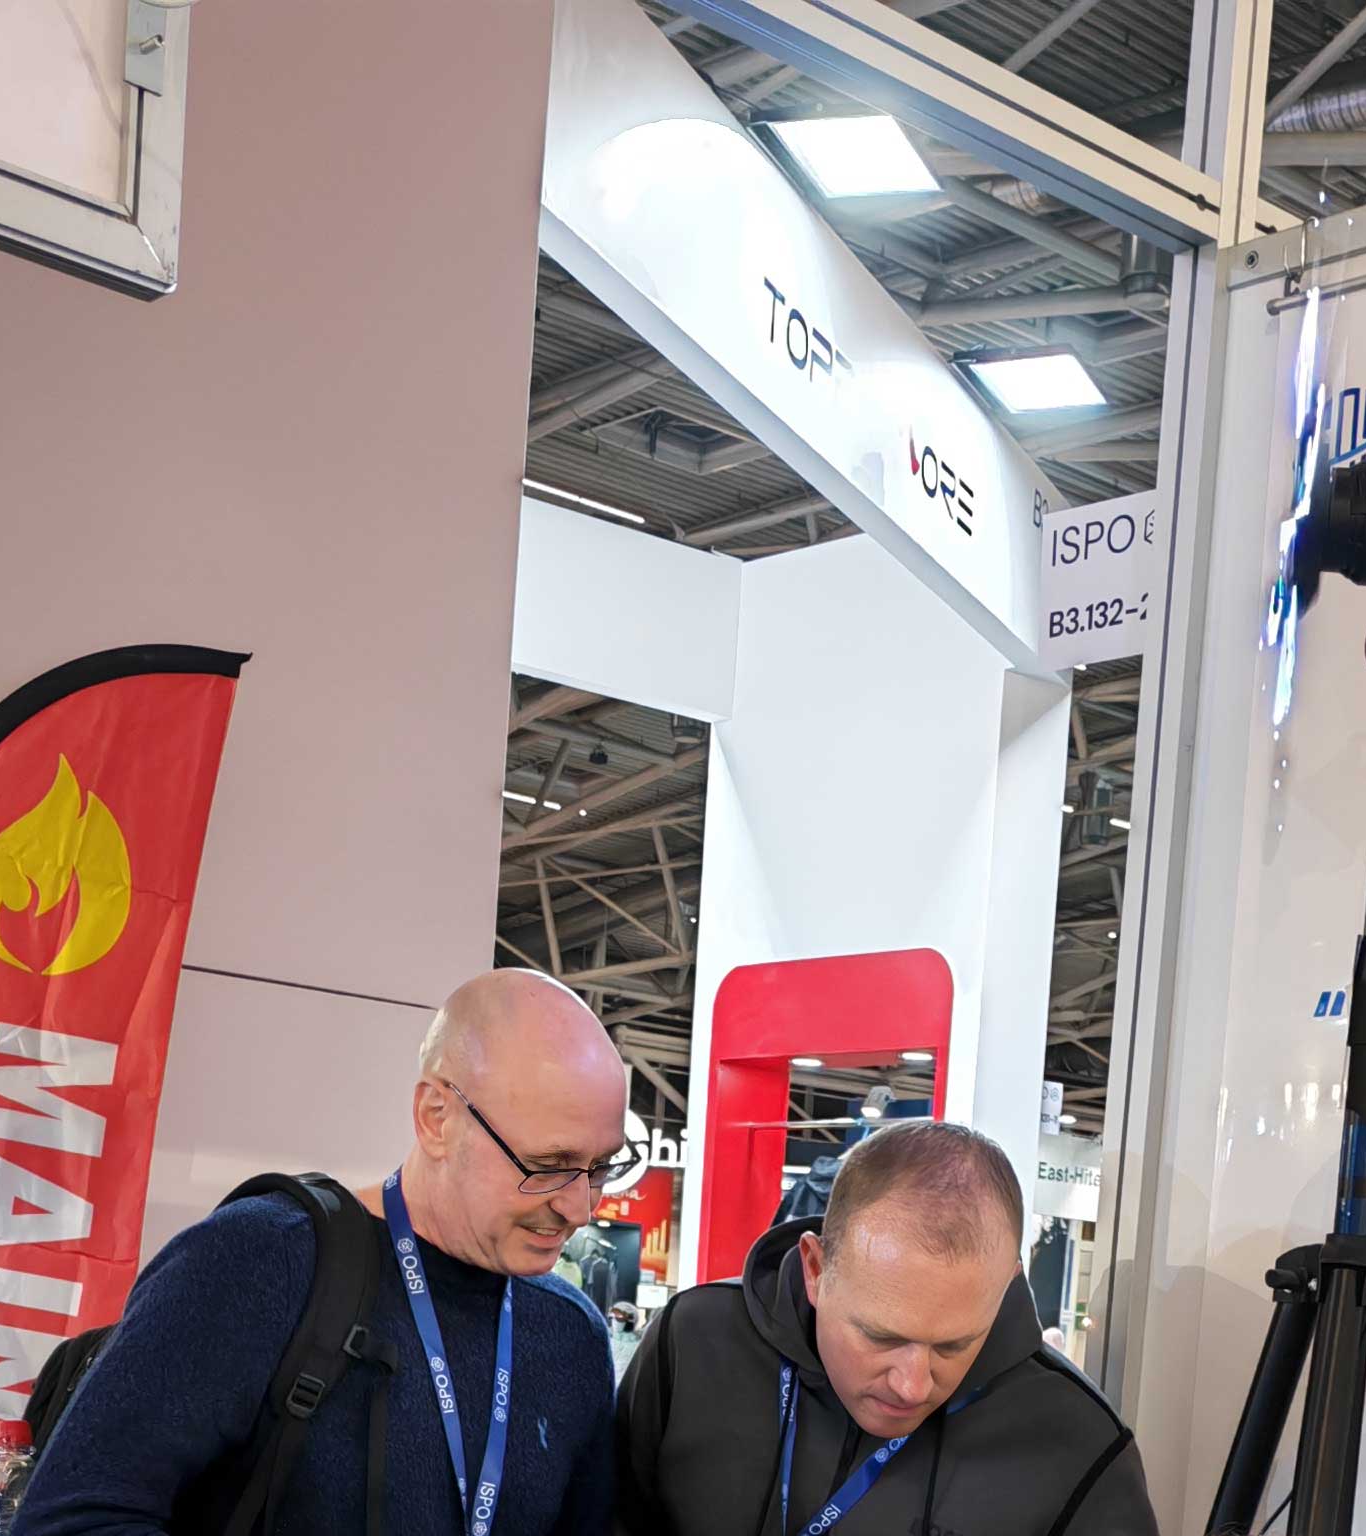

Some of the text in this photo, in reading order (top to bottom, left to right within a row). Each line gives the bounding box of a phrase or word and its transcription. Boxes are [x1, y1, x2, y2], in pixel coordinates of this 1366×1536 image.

[1052, 514, 1135, 567] ISPO
[402, 1255, 425, 1295] ISPO
[435, 1374, 455, 1414] ISPO
[496, 1368, 509, 1406] ISPO
[475, 1481, 496, 1519] ISPO
[809, 1503, 842, 1535] ISPO
